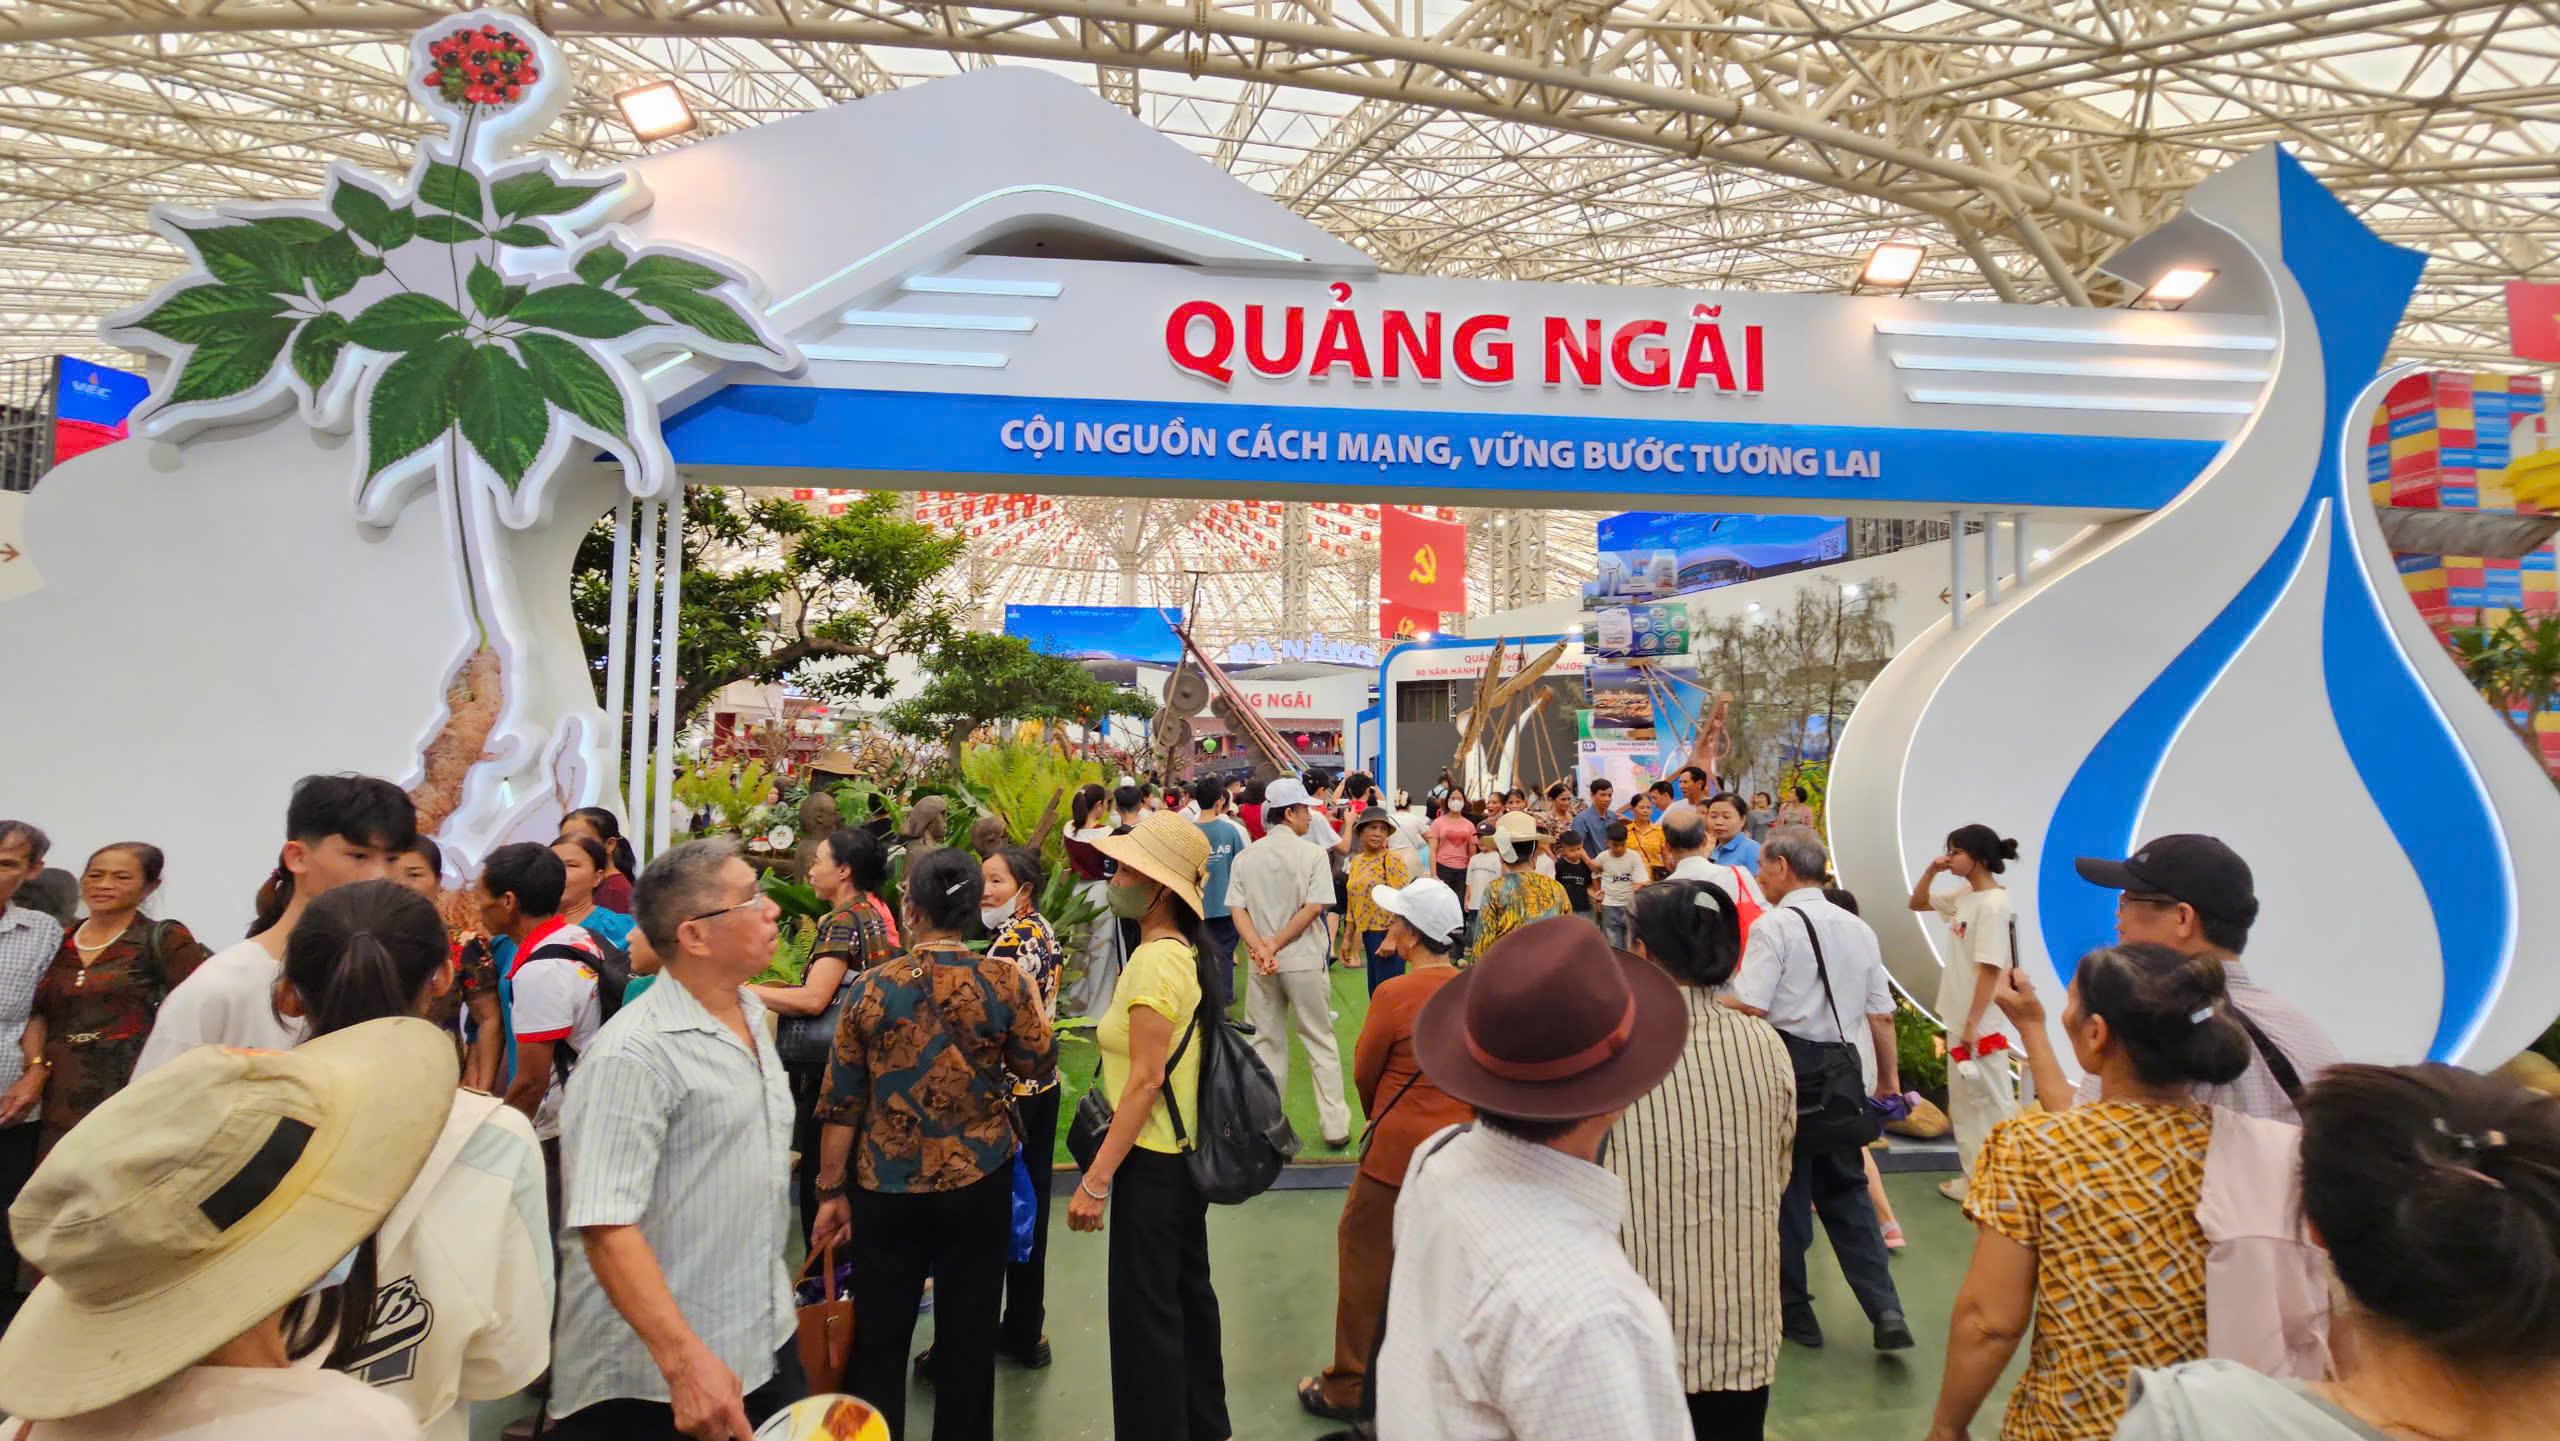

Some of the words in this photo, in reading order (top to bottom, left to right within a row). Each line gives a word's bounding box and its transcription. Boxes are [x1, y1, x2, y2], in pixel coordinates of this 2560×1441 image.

[1165, 281, 1515, 388] QUẢNG
[1543, 303, 1766, 397] NGÃI
[1000, 413, 1065, 460] CỘI
[1075, 415, 1217, 458] NGUỒN
[1226, 422, 1328, 461] CÁCH
[1337, 431, 1463, 471] MẠNG,
[1469, 431, 1576, 469] VỮNG
[1583, 436, 1685, 473] BƯỚC
[1690, 441, 1819, 477] TƯƠNG
[1825, 449, 1881, 478] LAI
[1228, 636, 1275, 662] ĐÀ
[1267, 691, 1312, 709] NGÃI
